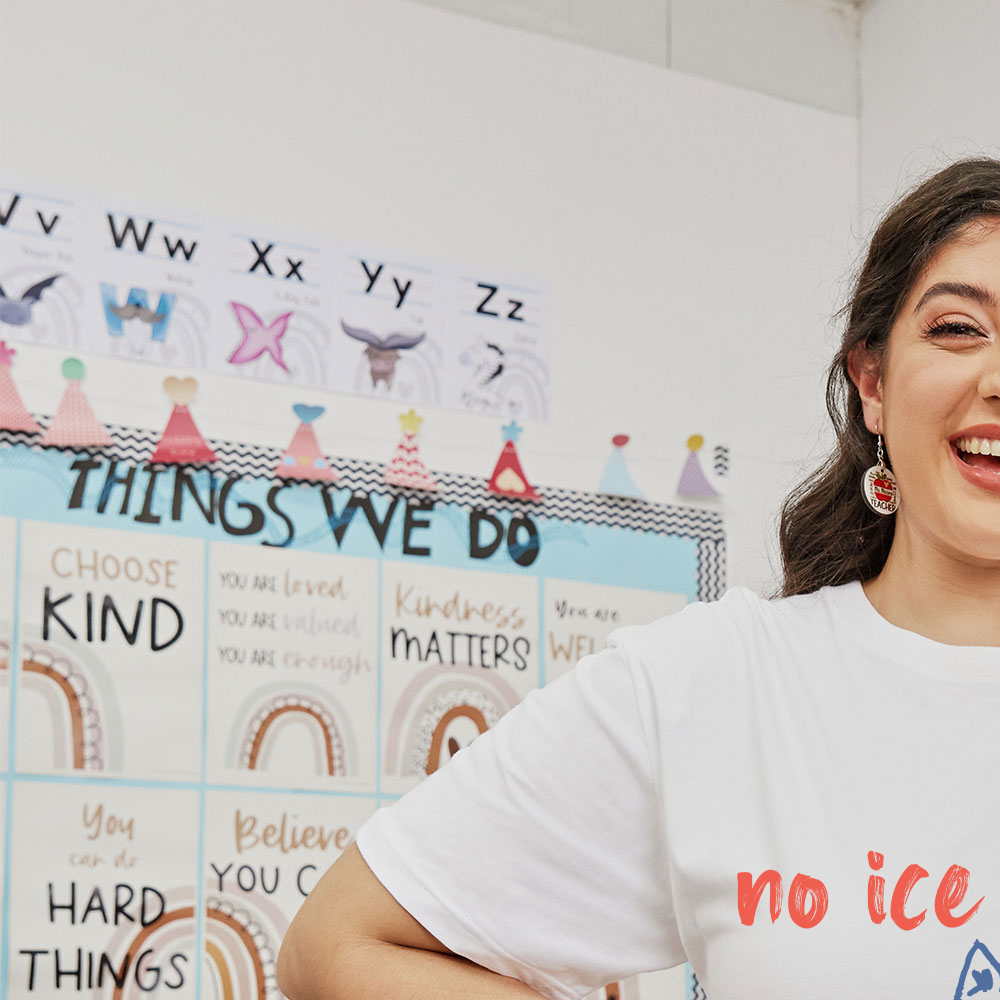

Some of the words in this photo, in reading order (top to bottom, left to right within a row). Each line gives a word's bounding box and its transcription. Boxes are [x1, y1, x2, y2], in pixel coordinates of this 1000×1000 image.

[107, 213, 153, 252] W
[163, 234, 197, 261] w
[249, 239, 274, 276] X
[286, 258, 304, 282] x
[361, 260, 383, 293] Y
[393, 277, 411, 309] y
[476, 282, 498, 316] Z
[507, 299, 524, 321] z
[67, 460, 295, 548] THINGS
[321, 488, 432, 558] WE
[470, 508, 541, 567] DO
[51, 547, 179, 589] CHOOSE
[218, 571, 248, 591] YOU
[251, 573, 277, 593] ARE
[282, 568, 348, 600] loved
[43, 586, 184, 652] KIND
[217, 608, 248, 630] YOU
[251, 610, 276, 631] ARE
[395, 582, 528, 631] Kindness
[217, 646, 248, 666] YOU
[250, 648, 276, 668] ARE
[390, 626, 531, 672] MATTERS
[82, 803, 135, 840] You
[234, 808, 350, 855] Believe
[69, 852, 105, 868] can
[113, 849, 137, 870] do
[210, 863, 279, 894] YOU
[48, 881, 166, 927] HARD
[737, 869, 829, 929] no
[867, 850, 986, 931] ice
[19, 948, 189, 992] THINGS
